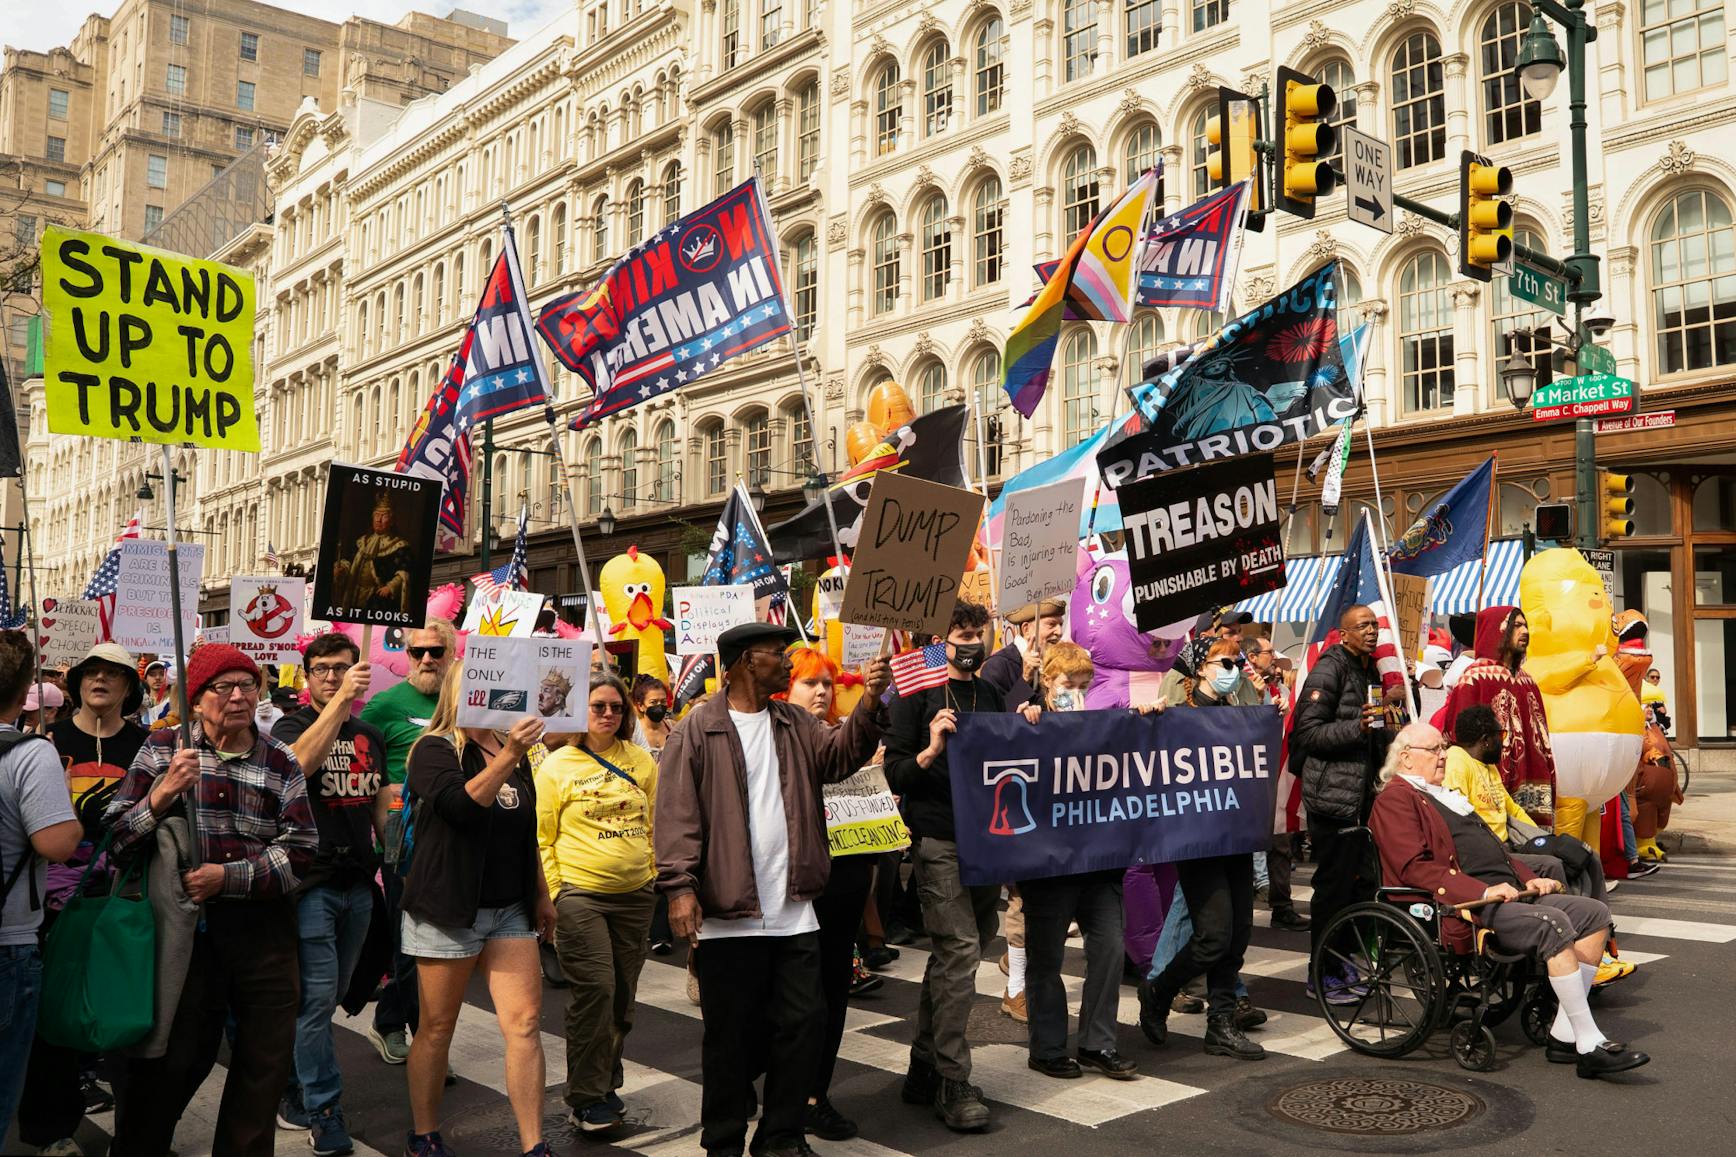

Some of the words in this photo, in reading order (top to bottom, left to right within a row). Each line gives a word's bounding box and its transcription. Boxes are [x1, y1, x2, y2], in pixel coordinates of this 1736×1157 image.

[1355, 140, 1383, 169] ONE
[1355, 163, 1385, 193] WAY
[59, 239, 244, 323] STAND
[1516, 268, 1539, 296] 7th
[1545, 281, 1559, 304] St
[72, 307, 153, 369] UP
[177, 325, 234, 382] TO
[1606, 360, 1615, 374] St
[1549, 385, 1605, 404] Market
[1612, 381, 1629, 396] St
[58, 371, 241, 438] TRUMP
[1536, 408, 1560, 419] Emma
[1562, 406, 1571, 415] C.
[1573, 400, 1609, 418] Chappell
[1612, 399, 1630, 411] Way
[1601, 419, 1623, 431] Avenue
[1625, 418, 1632, 428] of
[1632, 416, 1644, 427] Our
[1644, 414, 1673, 426] Founders
[1102, 398, 1359, 488] PATRIOTIC
[352, 473, 370, 485] AS
[375, 475, 422, 492] STUPID
[1056, 500, 1074, 516] the
[1123, 479, 1277, 560] TREASON
[875, 497, 961, 561] DUMP
[1008, 552, 1015, 567] is
[1058, 542, 1073, 554] the
[1590, 551, 1613, 561] RIGHT
[129, 559, 157, 570] ARE
[1134, 564, 1217, 603] PUNISHABLE
[1221, 558, 1238, 577] BY
[1241, 545, 1282, 571] DEATH
[818, 578, 831, 593] NO
[862, 569, 956, 618] TRUMP
[1026, 589, 1042, 602] Ben
[1044, 578, 1072, 596] Franklin
[127, 590, 155, 601] BUT
[54, 601, 99, 617] DEMOCRACY
[118, 605, 193, 619] PRESIDET
[326, 605, 343, 617] AS
[350, 607, 361, 618] IT
[367, 610, 413, 623] LOOKS.
[679, 601, 731, 619] Political
[55, 619, 96, 634] SPEECH
[681, 620, 730, 631] Displays
[50, 639, 90, 651] CHOICE
[231, 642, 265, 651] SPREAD
[469, 647, 497, 660] THE
[539, 647, 549, 658] IS
[551, 647, 572, 658] THE
[467, 669, 505, 682] ONLY
[468, 689, 487, 707] ill
[330, 739, 356, 755] PHEN
[1053, 744, 1269, 795] INDIVISIBLE
[320, 772, 382, 797] SUCKS
[839, 796, 894, 817] US-FUNDED
[1052, 787, 1241, 828] PHILADELPHIA
